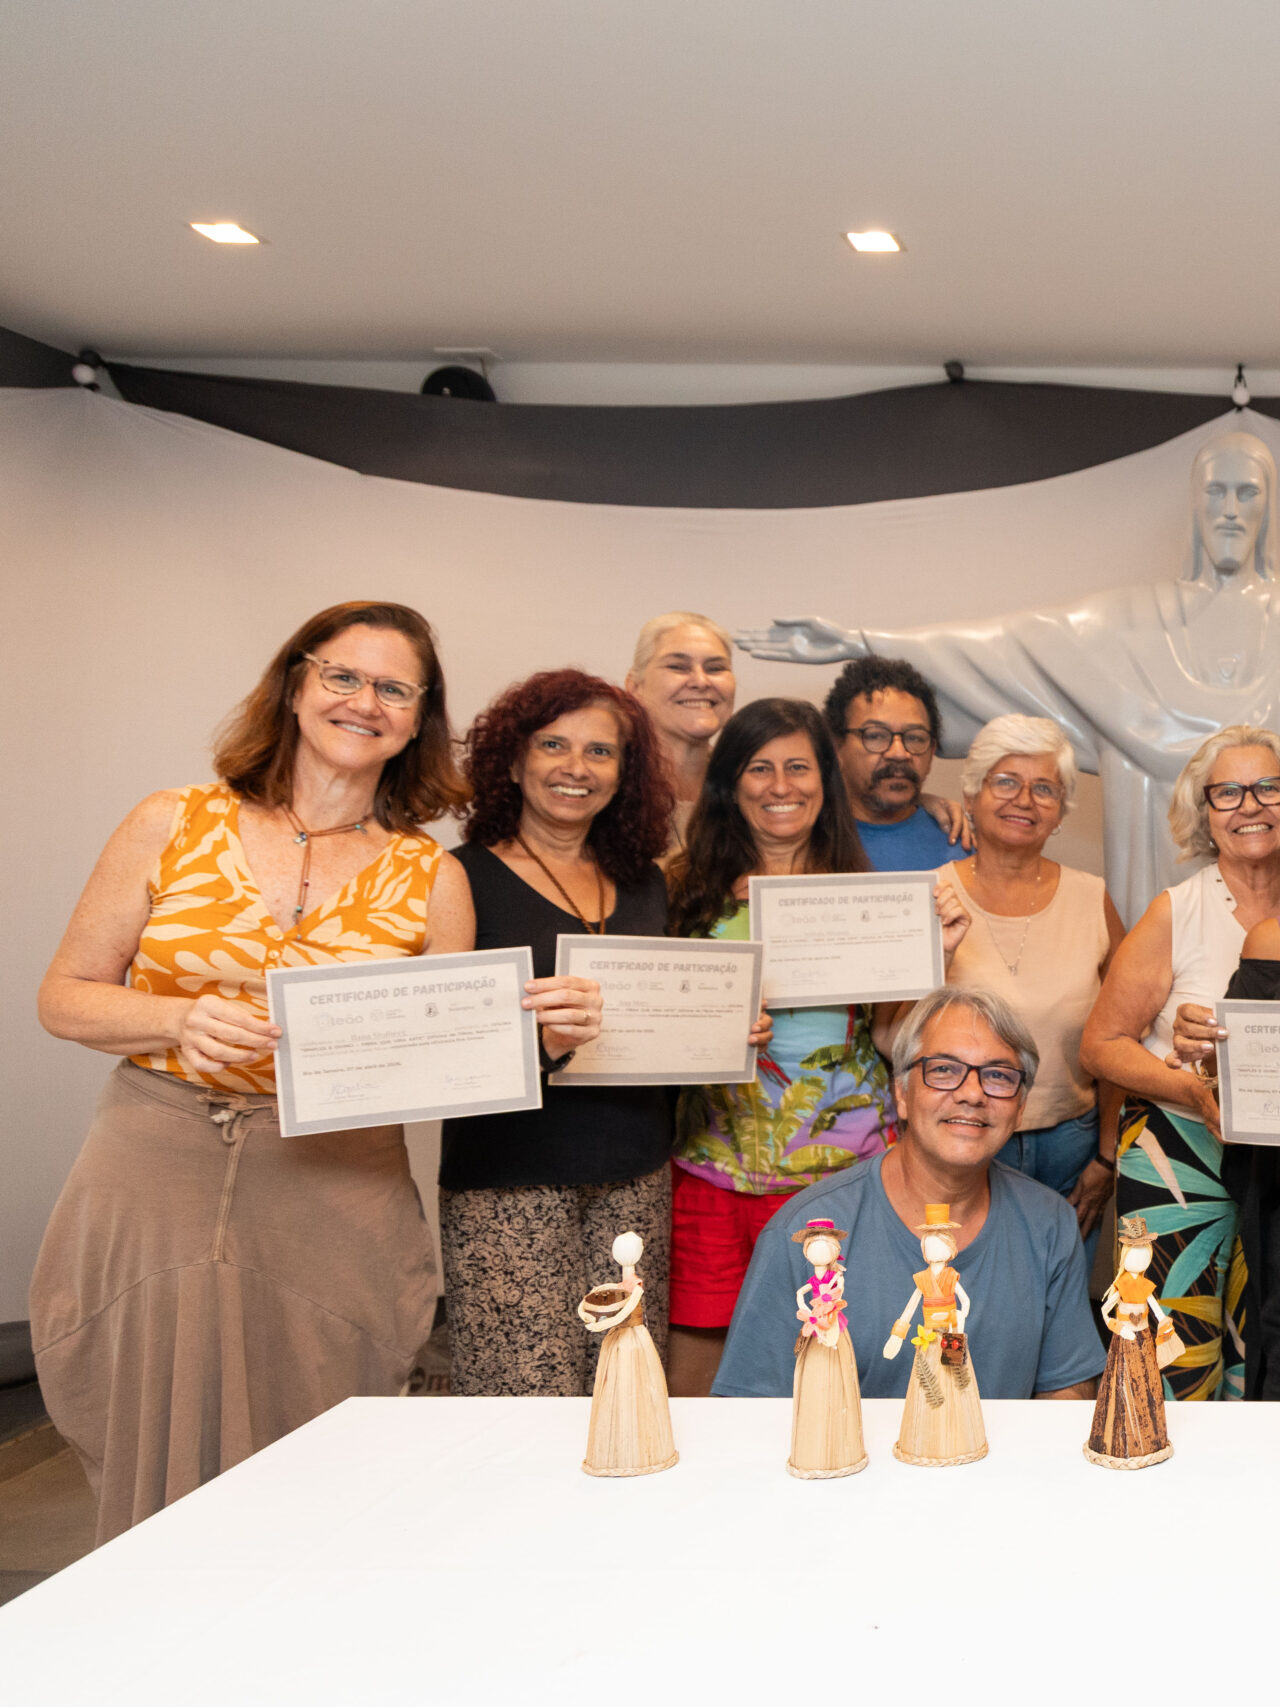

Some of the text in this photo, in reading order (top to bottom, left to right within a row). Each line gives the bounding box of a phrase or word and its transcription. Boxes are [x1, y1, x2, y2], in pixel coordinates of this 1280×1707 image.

[778, 892, 913, 907] CERTIFICADO DE PARTICIPAÇÃO
[590, 960, 737, 974] CERTIFICADO DE PARTICIPAÇÃO
[309, 976, 496, 1005] CERTIFICADO DE PARTICIPAÇÃO
